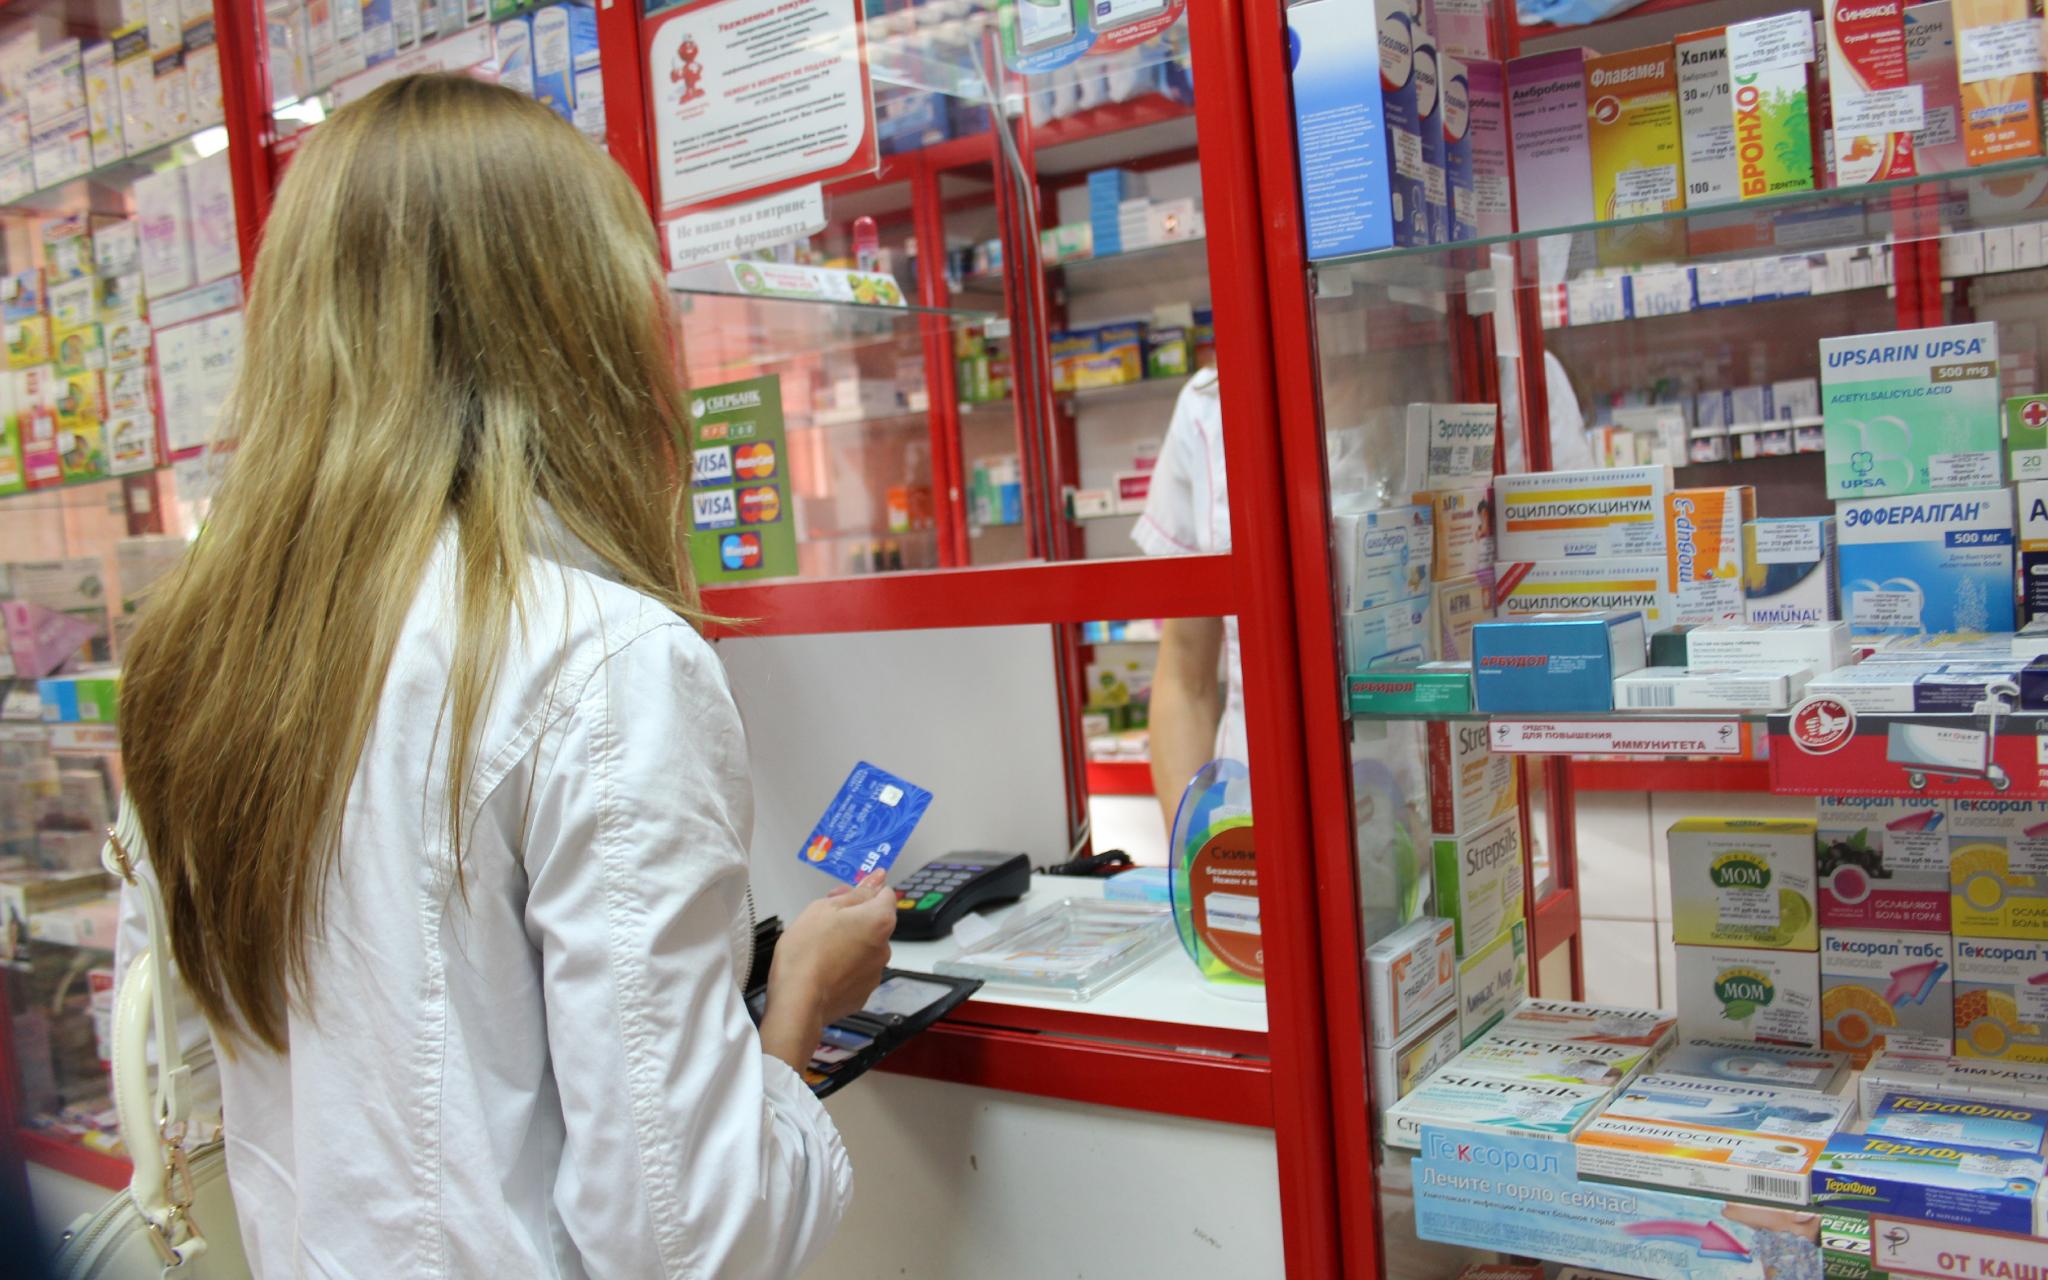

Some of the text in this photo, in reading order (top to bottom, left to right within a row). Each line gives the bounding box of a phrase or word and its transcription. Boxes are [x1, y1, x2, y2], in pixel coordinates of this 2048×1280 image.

[1837, 3, 1897, 22] Синекод
[1591, 60, 1665, 87] Флавамед
[1513, 80, 1581, 100] Амбробене
[1689, 182, 1709, 194] 100
[677, 200, 807, 239] Не нашли на витрине
[678, 221, 807, 261] спросите фармацевта
[1828, 338, 1982, 368] UPSARIN UPSA
[1938, 366, 1989, 378] 500 mg
[706, 390, 761, 411] СБЕРБАНК
[1831, 386, 1953, 404] ACETYLSALICYLIC ACID
[694, 453, 728, 472] VISA
[2022, 455, 2041, 467] 20
[1841, 478, 1886, 489] UPSA
[700, 496, 732, 515] VISA
[1506, 500, 1651, 520] ОЦИЛЛОКОКЦИНУМ
[1845, 502, 1980, 527] ЭФФЕРАЛГАН
[1954, 533, 2000, 544] 500 мг
[1508, 594, 1655, 611] ОЦИЛЛОКОКЦИНУМ
[1753, 609, 1820, 621] IMMUNAL
[1480, 655, 1548, 668] АРБИДОЛ
[1353, 681, 1414, 694] АРБИДОЛ
[1612, 740, 1706, 750] ИММУНИТЕТА
[1466, 826, 1518, 876] Strepsils
[1720, 868, 1762, 884] МОМ
[1826, 937, 1943, 958] Гексорал табс
[1958, 943, 2036, 962] Гексорал
[1724, 983, 1764, 1000] МОМ
[1531, 1001, 1660, 1021] Strepsils
[1490, 1036, 1625, 1058] Strepsils
[1690, 1039, 1830, 1059] Фалиминт
[1437, 1074, 1583, 1099] Strepsils
[1641, 1076, 1782, 1098] Солисепт
[1893, 1096, 2032, 1121] ТераФлю
[1597, 1121, 1749, 1146] ФАРИНГОСЕПТ
[1427, 1132, 1560, 1175] Гексорал
[1423, 1168, 1637, 1216] Лечите горло сейчас!
[1825, 1178, 1876, 1195] ТераФлю
[1937, 1252, 1971, 1273] ОТ
